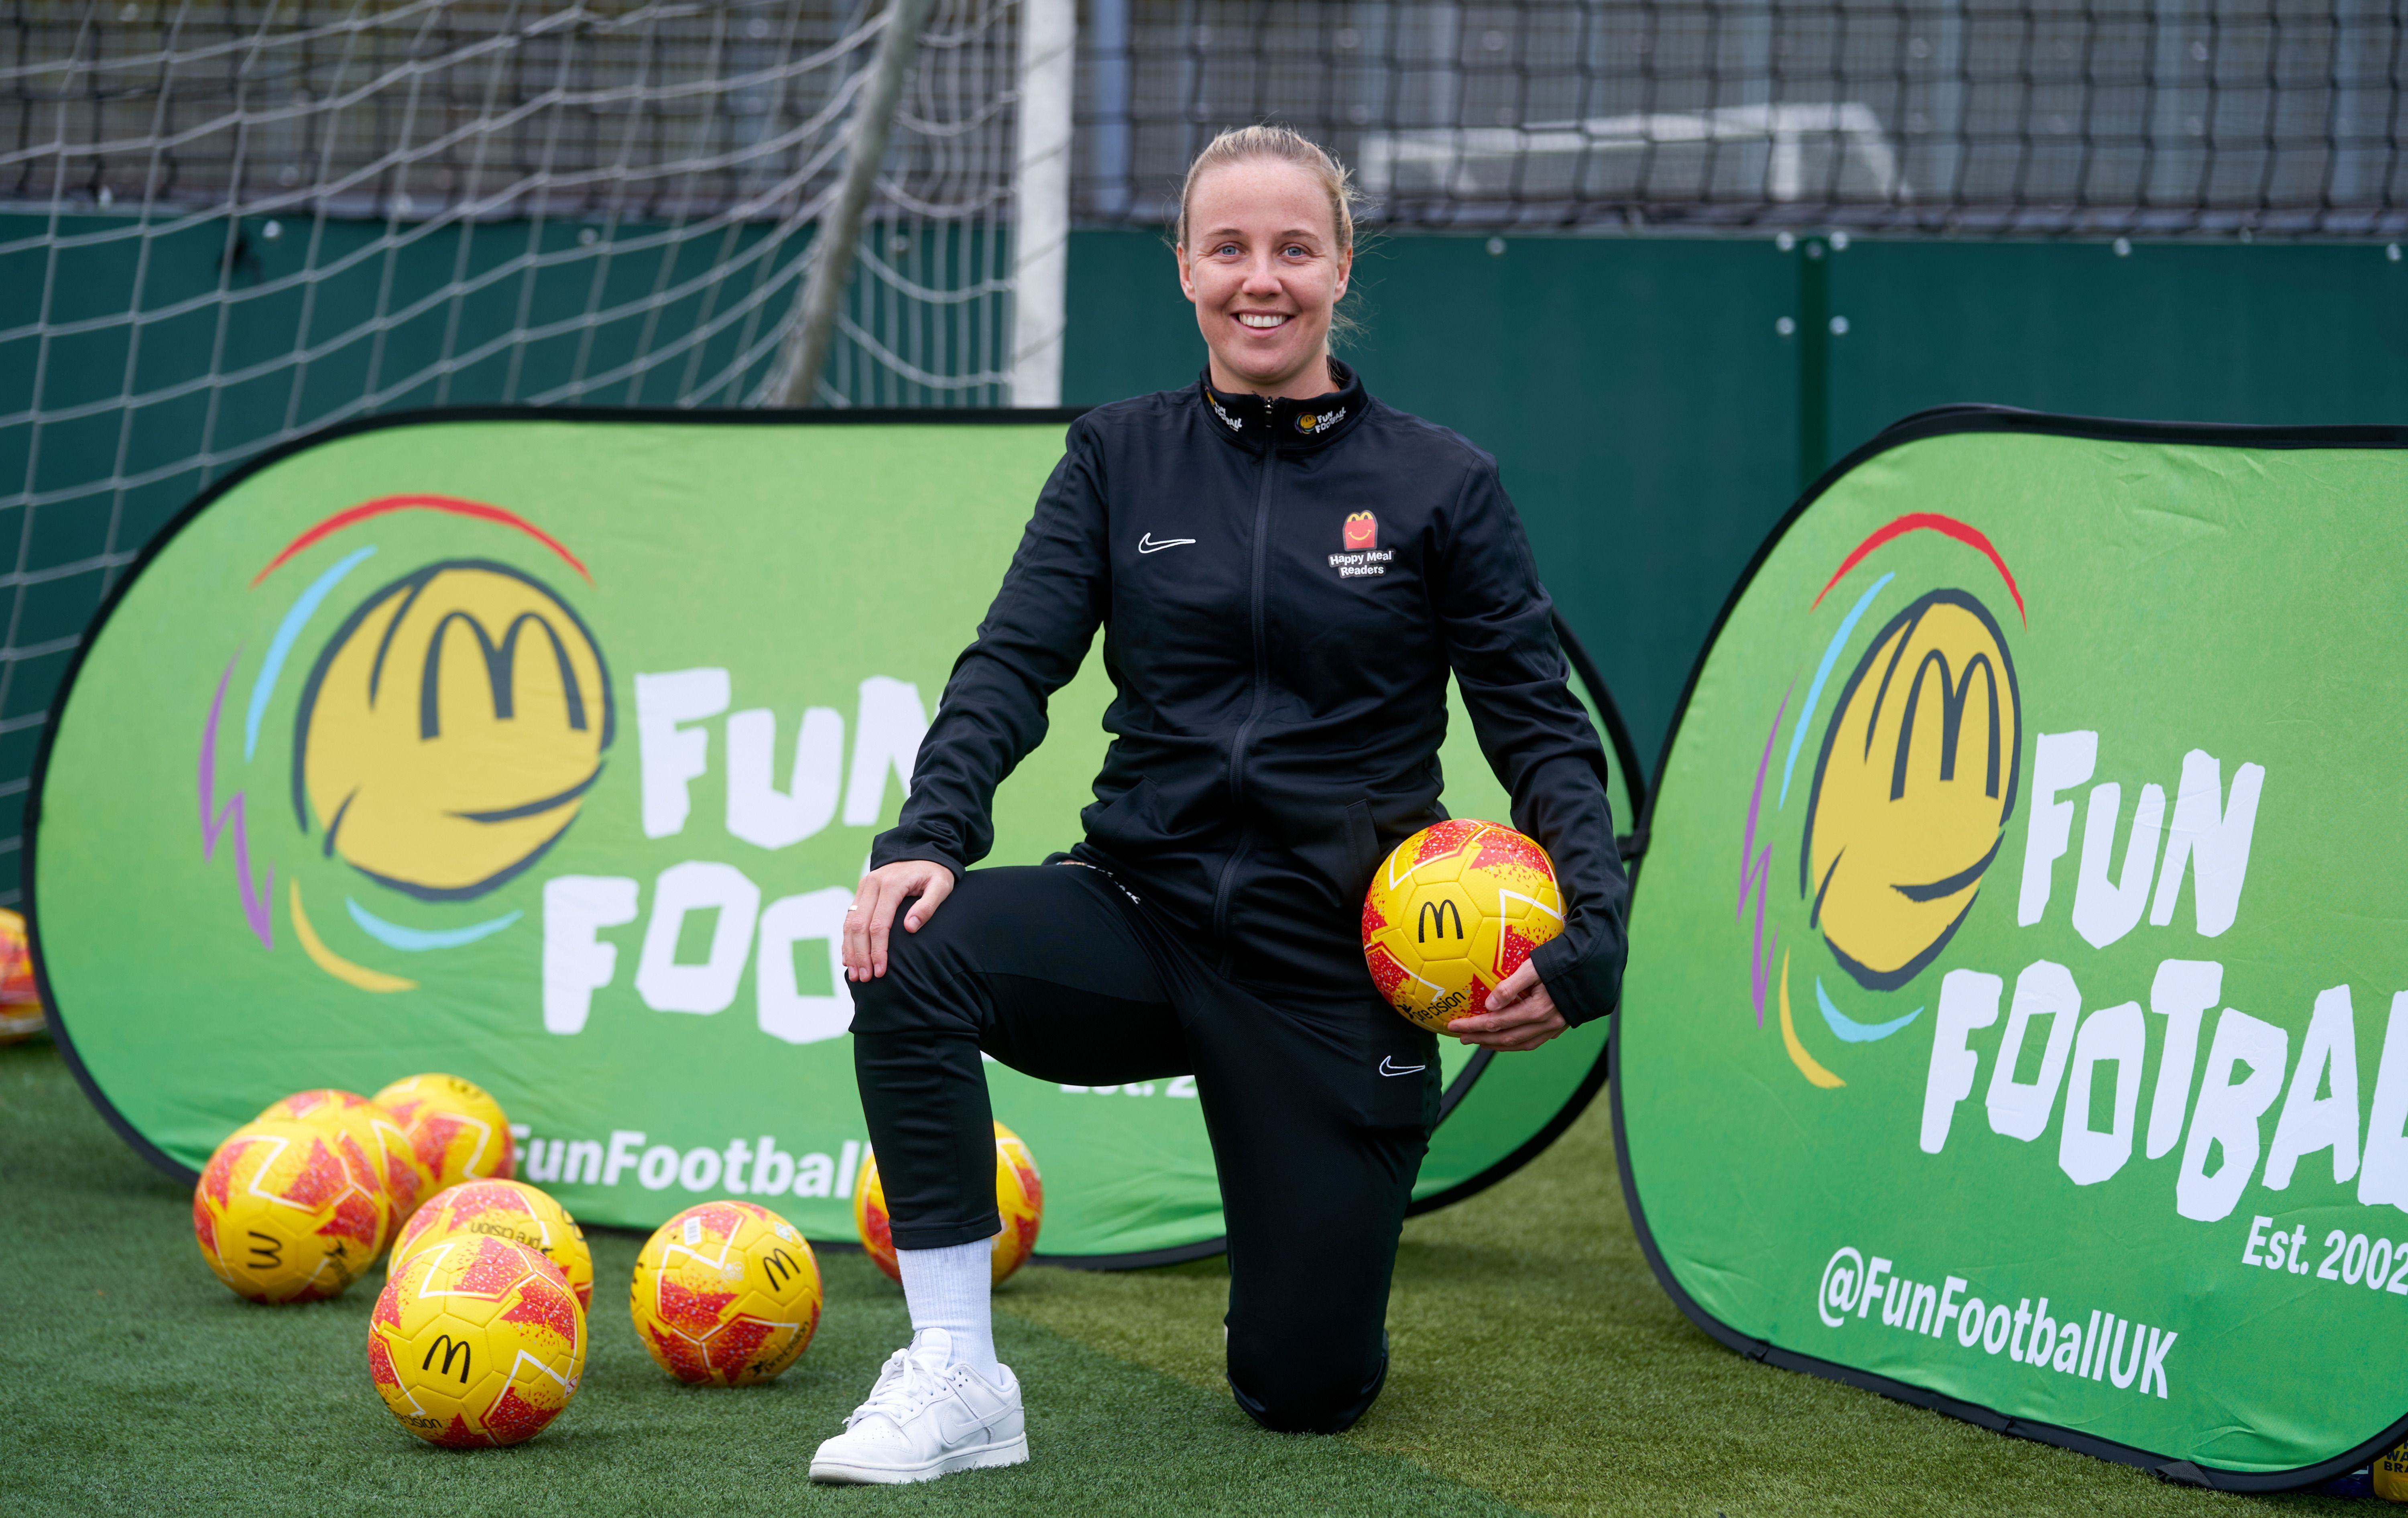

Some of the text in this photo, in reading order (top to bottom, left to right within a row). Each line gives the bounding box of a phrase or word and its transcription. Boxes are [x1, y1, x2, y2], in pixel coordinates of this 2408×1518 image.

[1315, 407, 1346, 433] FOOTBALL
[1317, 411, 1332, 423] FUN
[1330, 551, 1392, 566] Happy Meal
[1340, 565, 1384, 576] Readers
[2018, 730, 2265, 949] FUN
[1412, 992, 1466, 1021] precision
[2242, 1215, 2408, 1295] Est. 2002
[1818, 1246, 2178, 1399] @FunFootballUK
